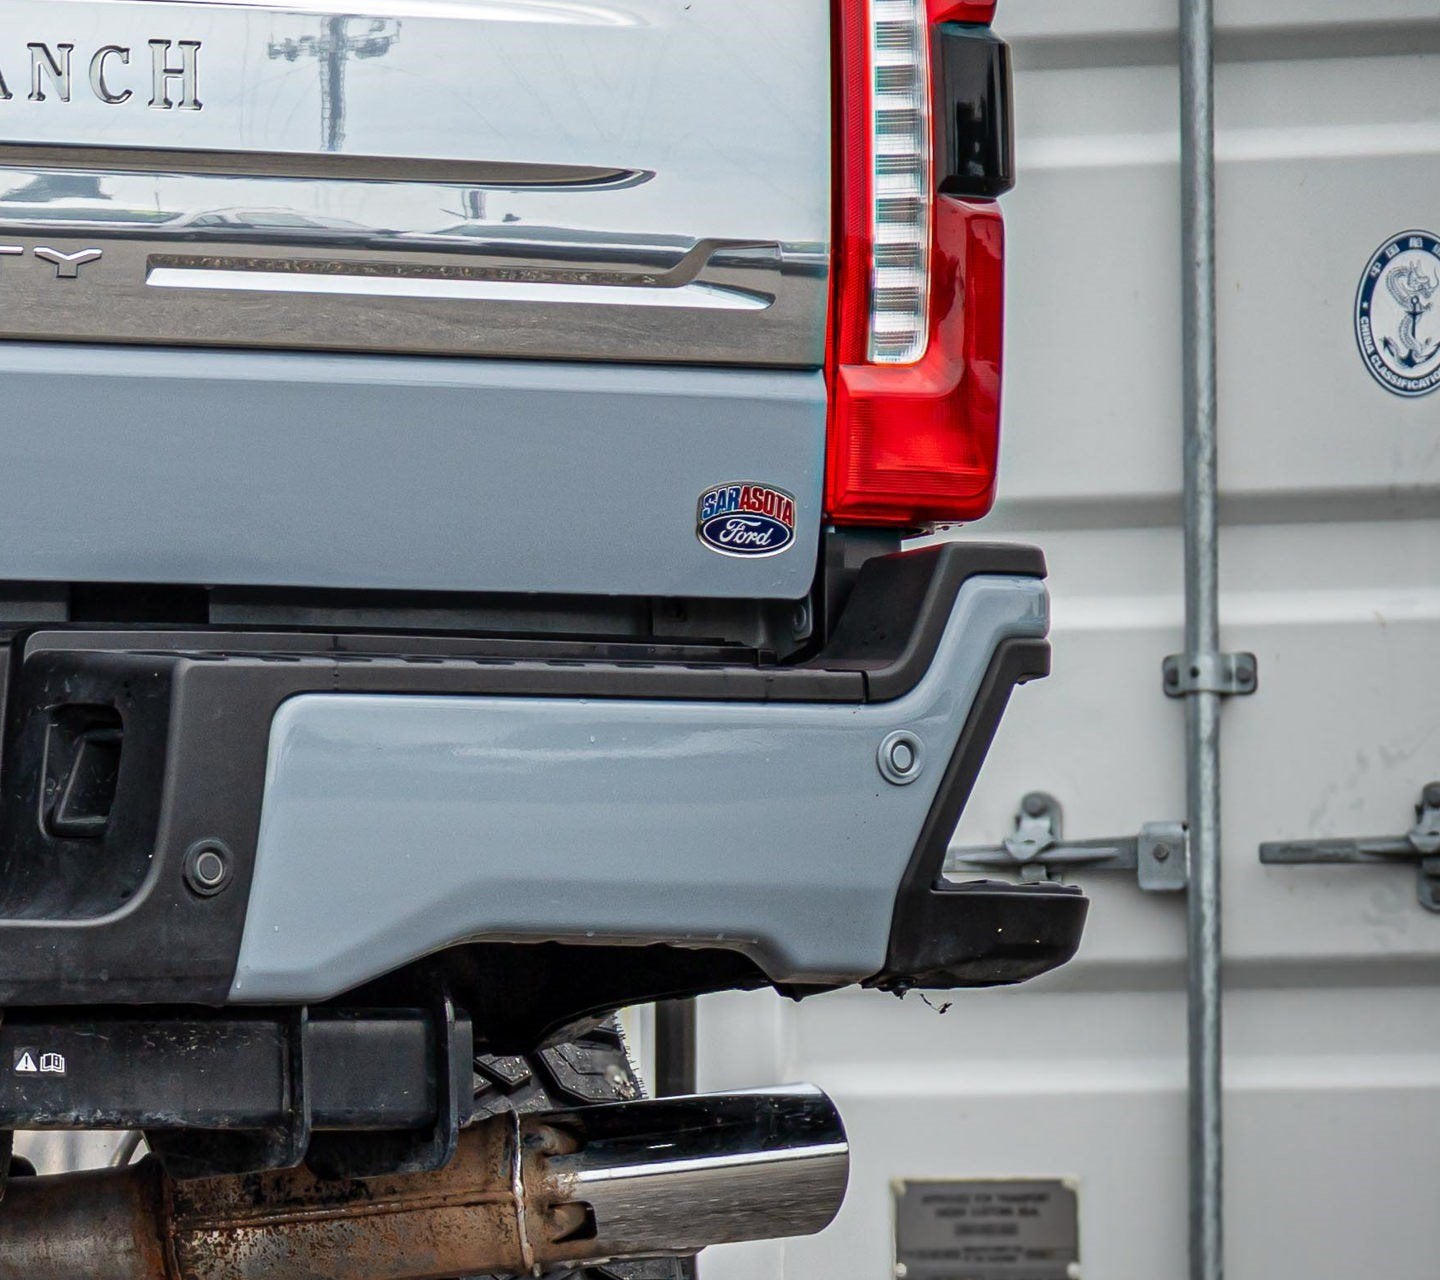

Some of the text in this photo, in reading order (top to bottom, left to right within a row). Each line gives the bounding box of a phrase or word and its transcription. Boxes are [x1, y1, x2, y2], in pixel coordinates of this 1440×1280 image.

[1359, 315, 1440, 390] CHINA CLASSIFICATIO
[701, 484, 794, 528] SARASOTA
[719, 518, 775, 546] Ford
